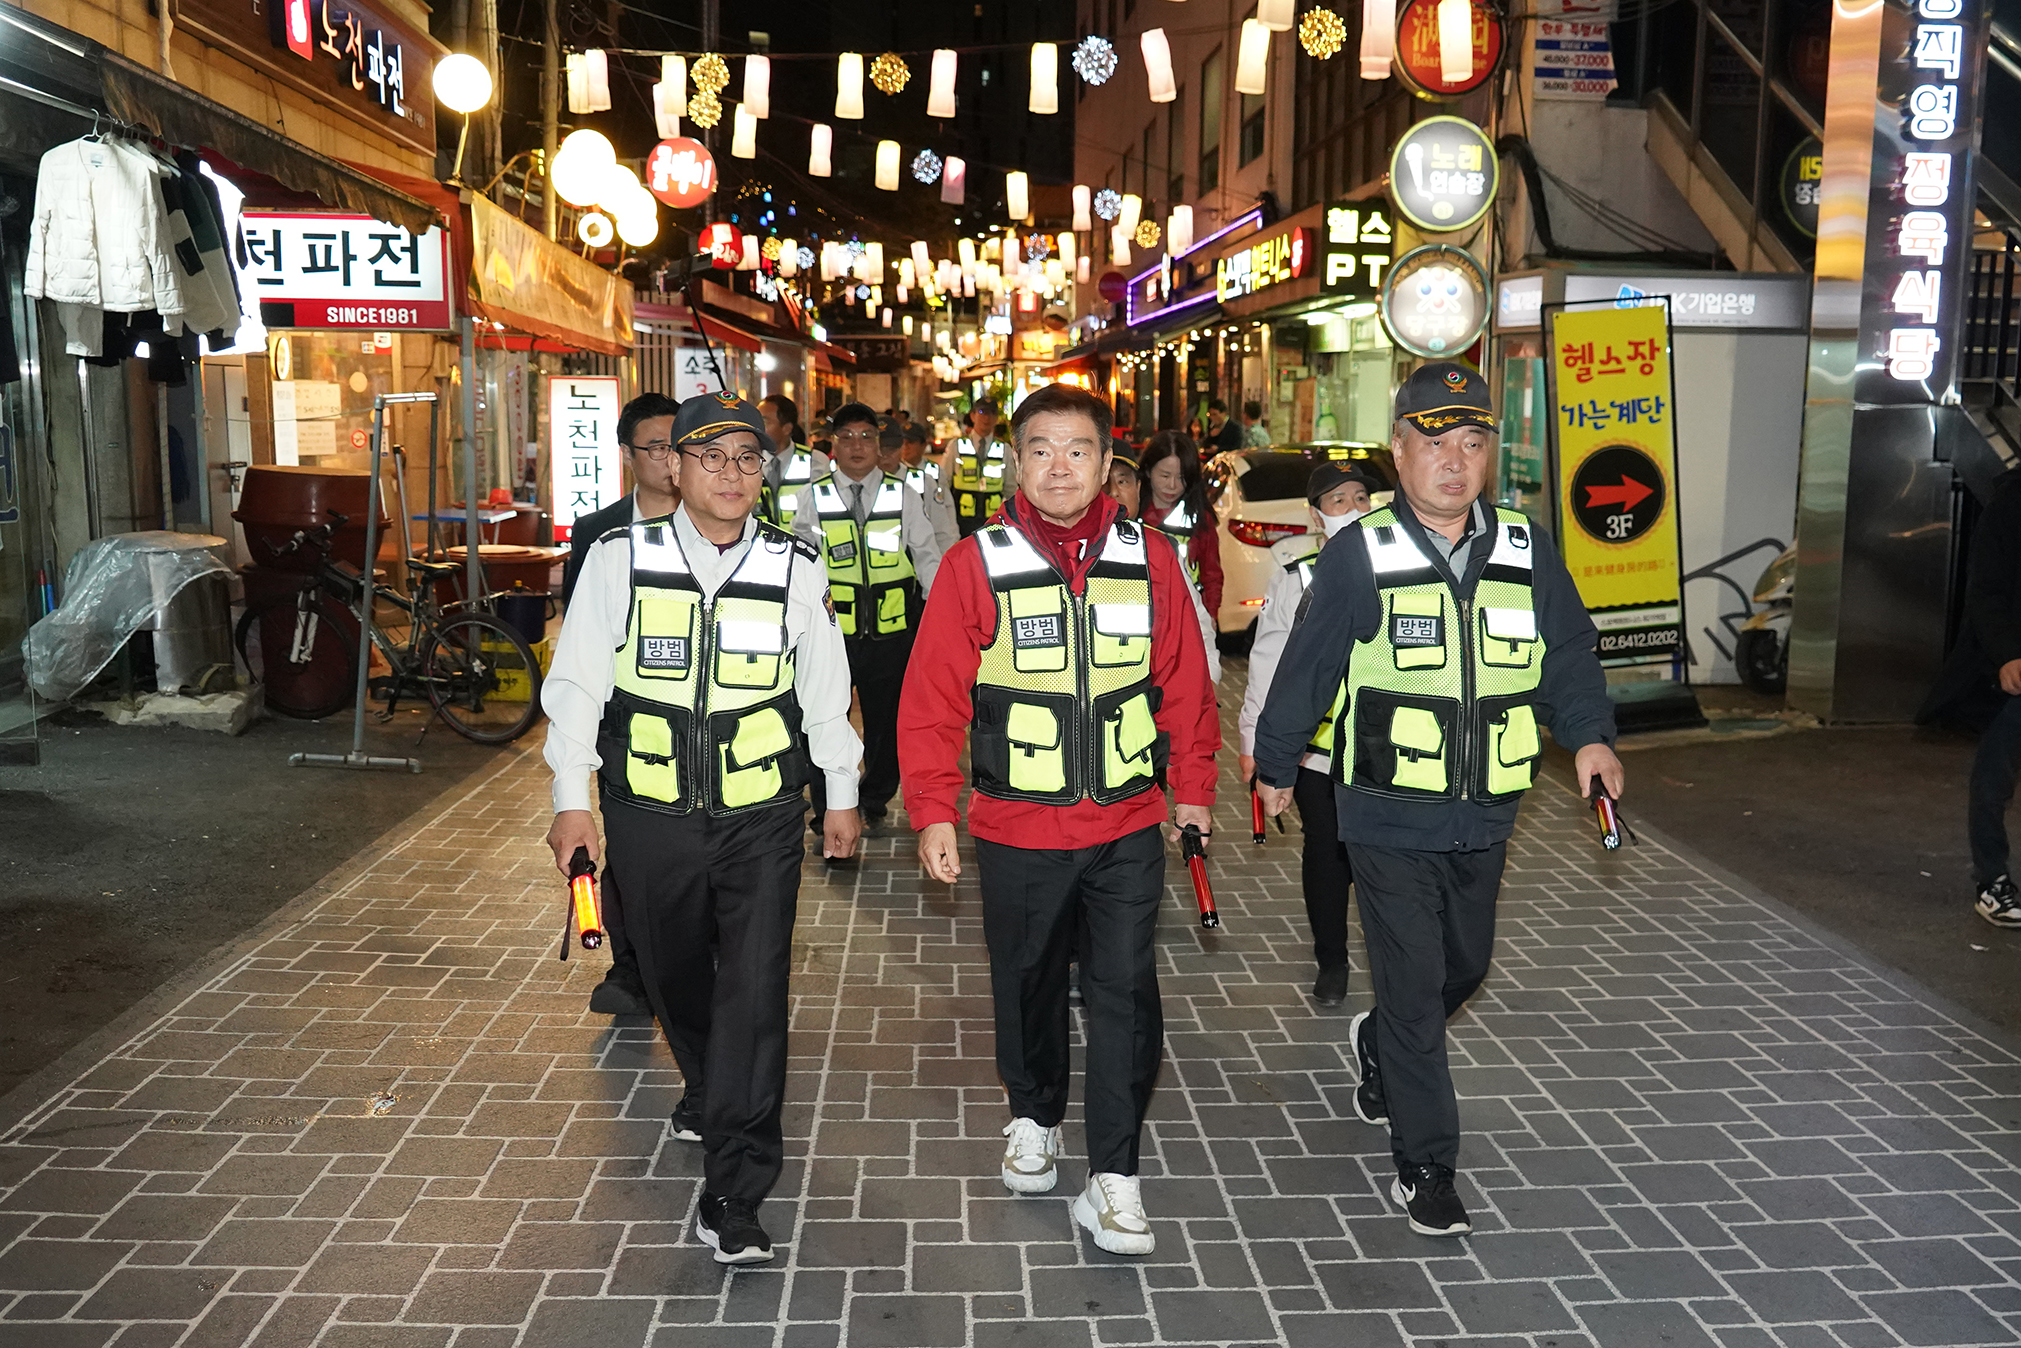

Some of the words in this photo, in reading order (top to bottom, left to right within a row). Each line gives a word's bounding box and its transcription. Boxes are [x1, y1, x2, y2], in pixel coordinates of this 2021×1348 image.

[1430, 142, 1483, 171] 노래
[1429, 170, 1485, 196] 연습장
[1327, 208, 1391, 244] 헬스
[1326, 253, 1390, 287] PT
[1889, 152, 1952, 381] 정육식당
[1405, 314, 1469, 337] 당구장
[684, 356, 719, 375] 소주
[1562, 338, 1661, 383] 헬스장
[567, 385, 602, 520] 노천파전
[1606, 513, 1633, 539] 3F
[1020, 618, 1054, 637] 방범
[1400, 619, 1433, 636] 방범
[648, 639, 681, 658] 방범
[1040, 637, 1060, 645] PATROL
[643, 659, 666, 667] CITIZENS
